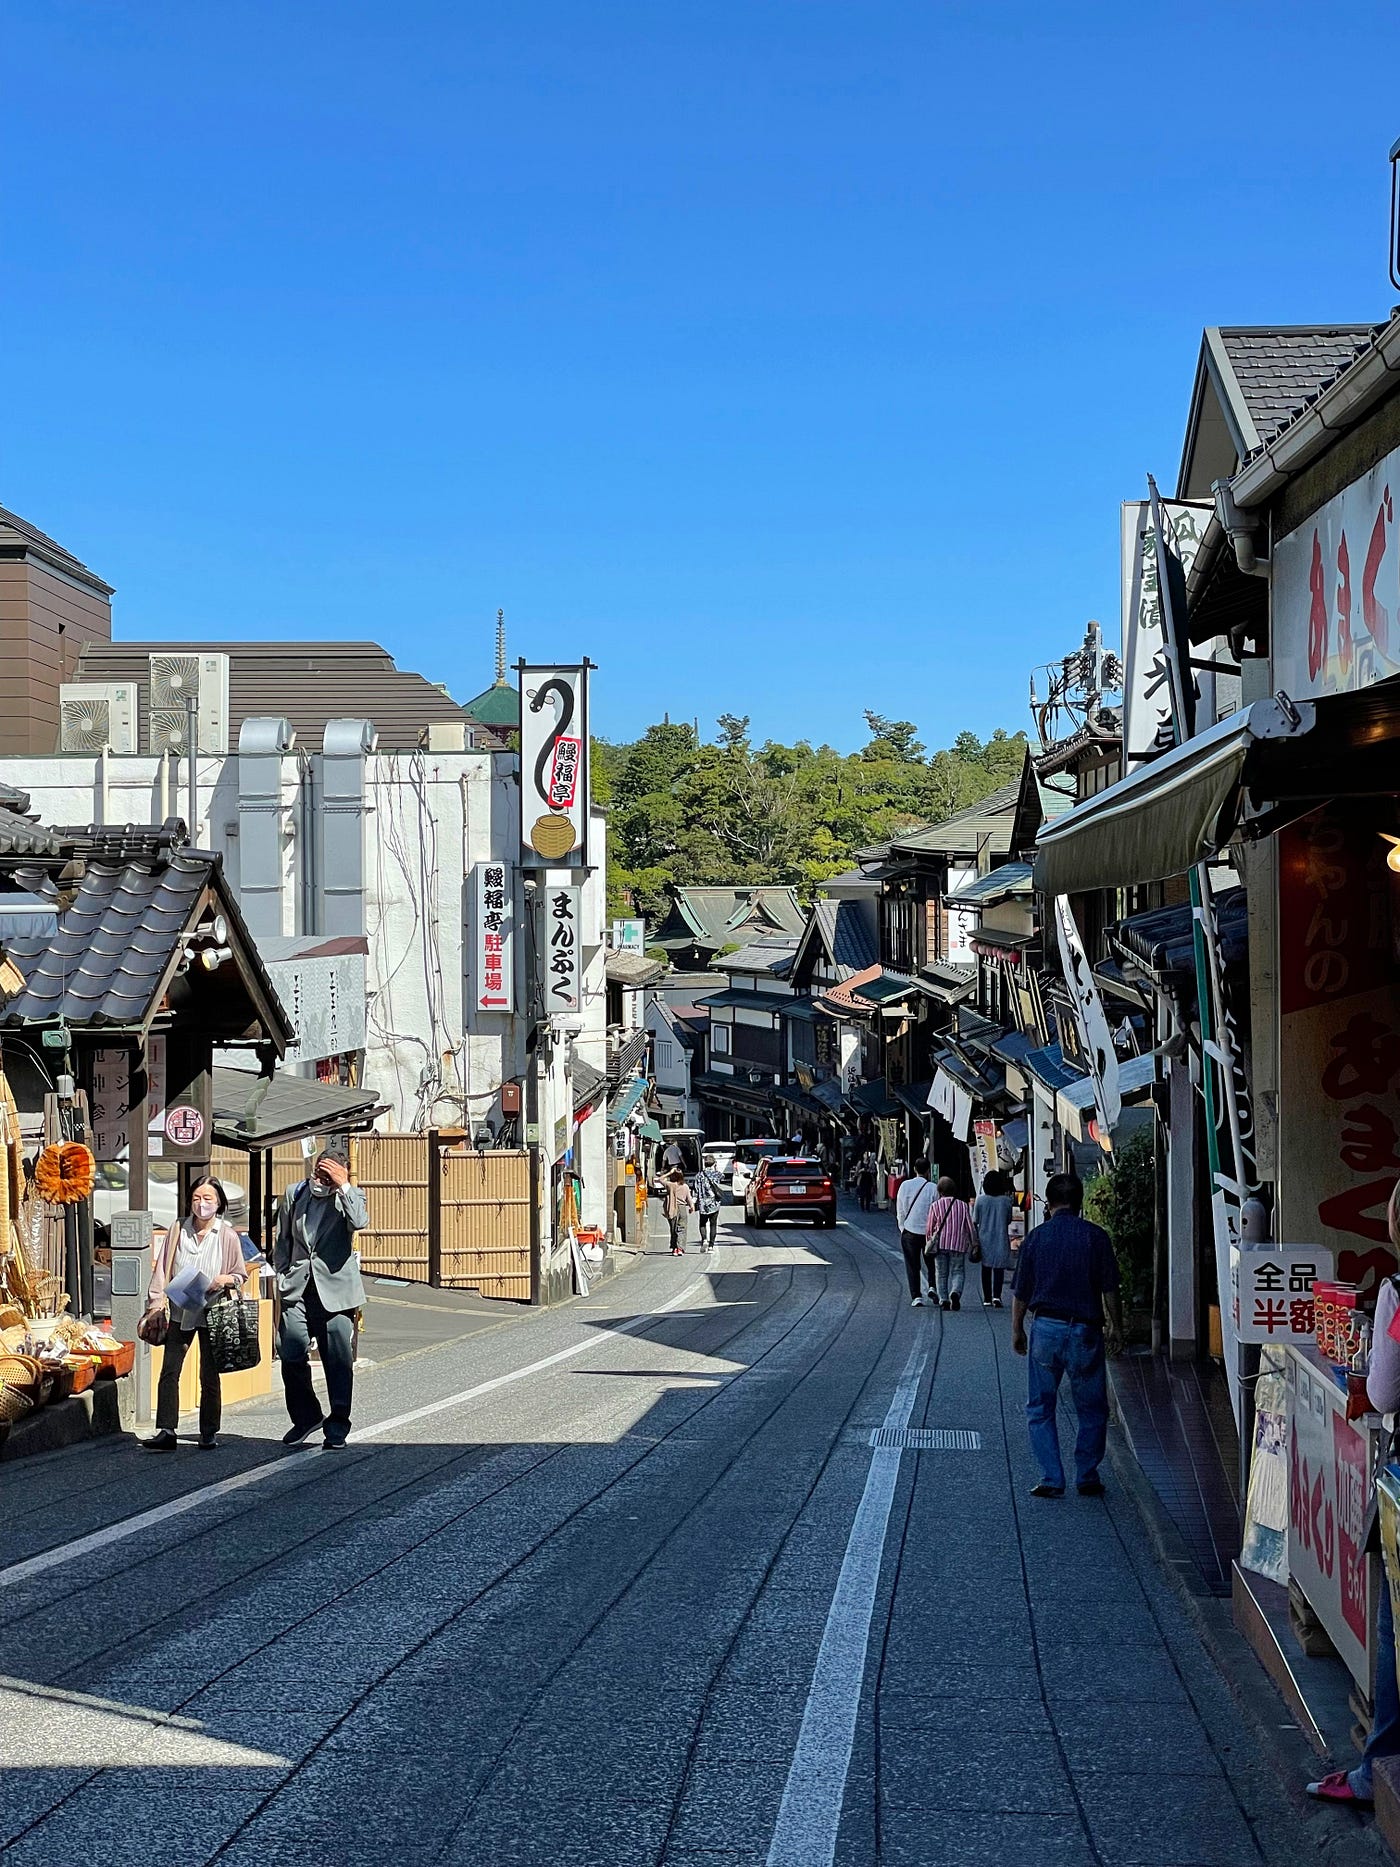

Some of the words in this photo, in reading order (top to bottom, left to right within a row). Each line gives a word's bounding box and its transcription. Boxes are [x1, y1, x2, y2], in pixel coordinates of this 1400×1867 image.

[552, 739, 577, 804] 鰻福亭
[550, 891, 575, 1003] まんぷく
[1253, 1262, 1318, 1292] 全品
